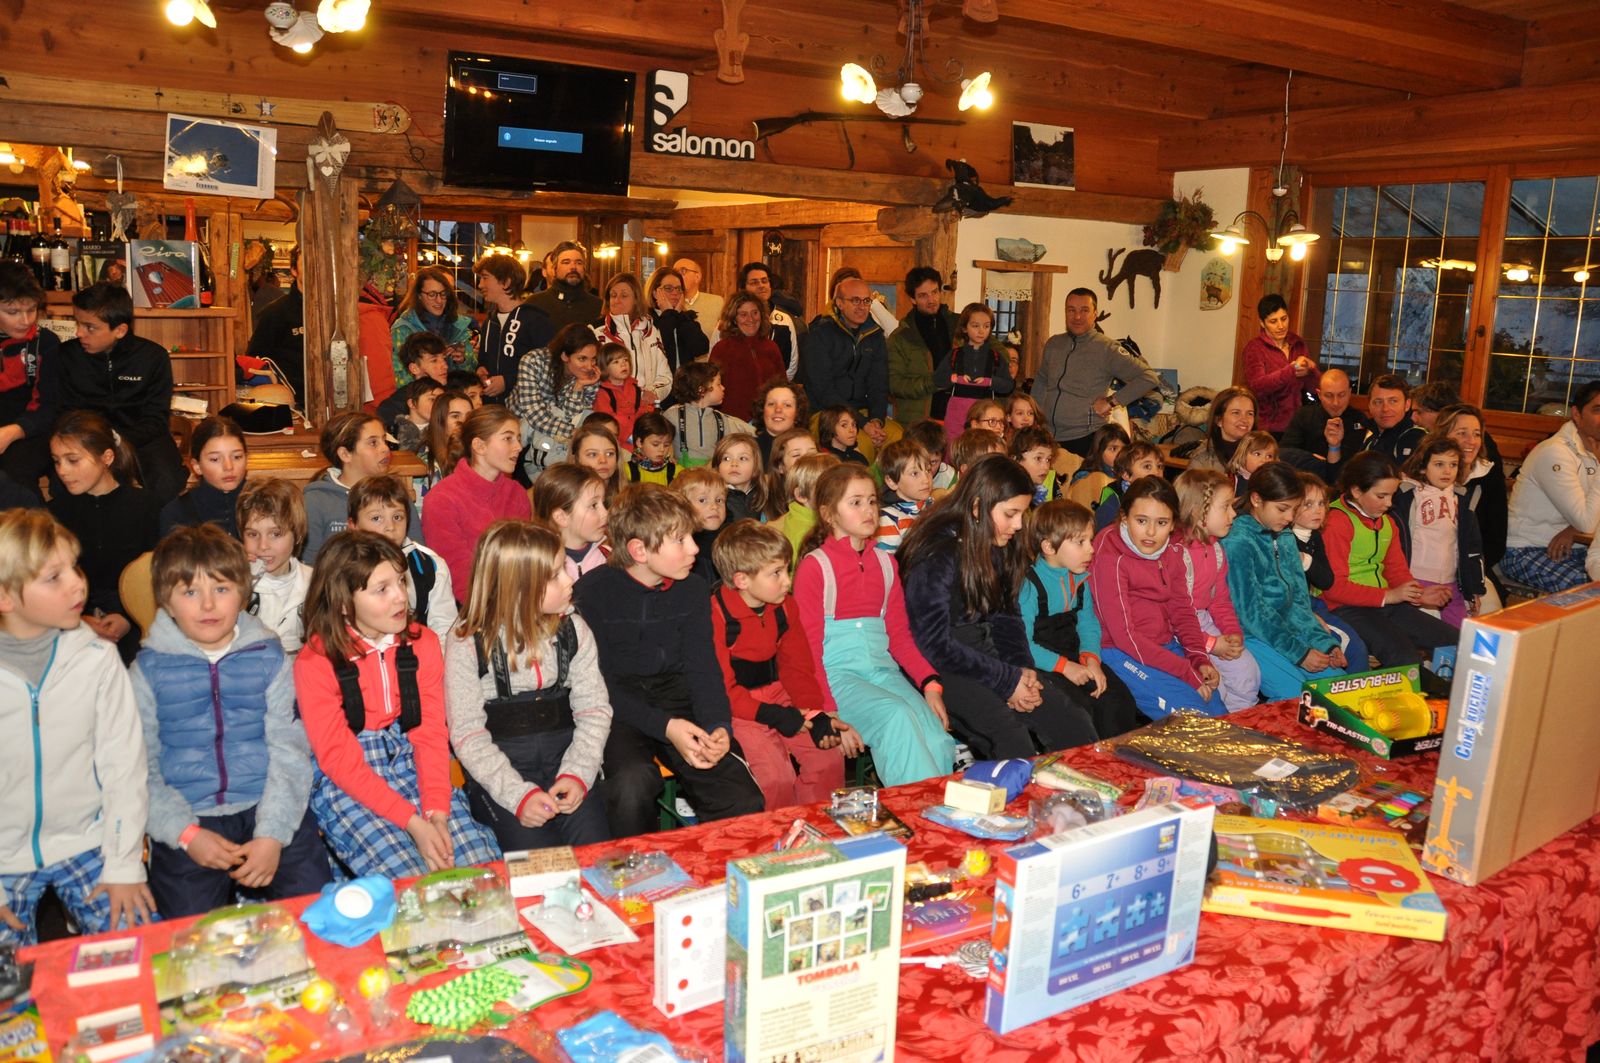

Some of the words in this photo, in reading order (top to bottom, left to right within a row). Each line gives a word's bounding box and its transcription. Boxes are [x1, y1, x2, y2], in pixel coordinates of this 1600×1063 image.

[653, 127, 755, 159] salomon
[138, 246, 189, 258] Riva
[503, 319, 521, 358] POC
[1124, 661, 1149, 680] GORE-TEX
[1330, 672, 1402, 694] TRI-BLASTER
[1326, 720, 1371, 744] TRI-BLASTER
[1072, 883, 1086, 899] 6+
[1105, 873, 1120, 889] 7+
[1134, 865, 1148, 880] 8+
[1157, 858, 1170, 873] 9+
[796, 961, 860, 987] TOMBOLA
